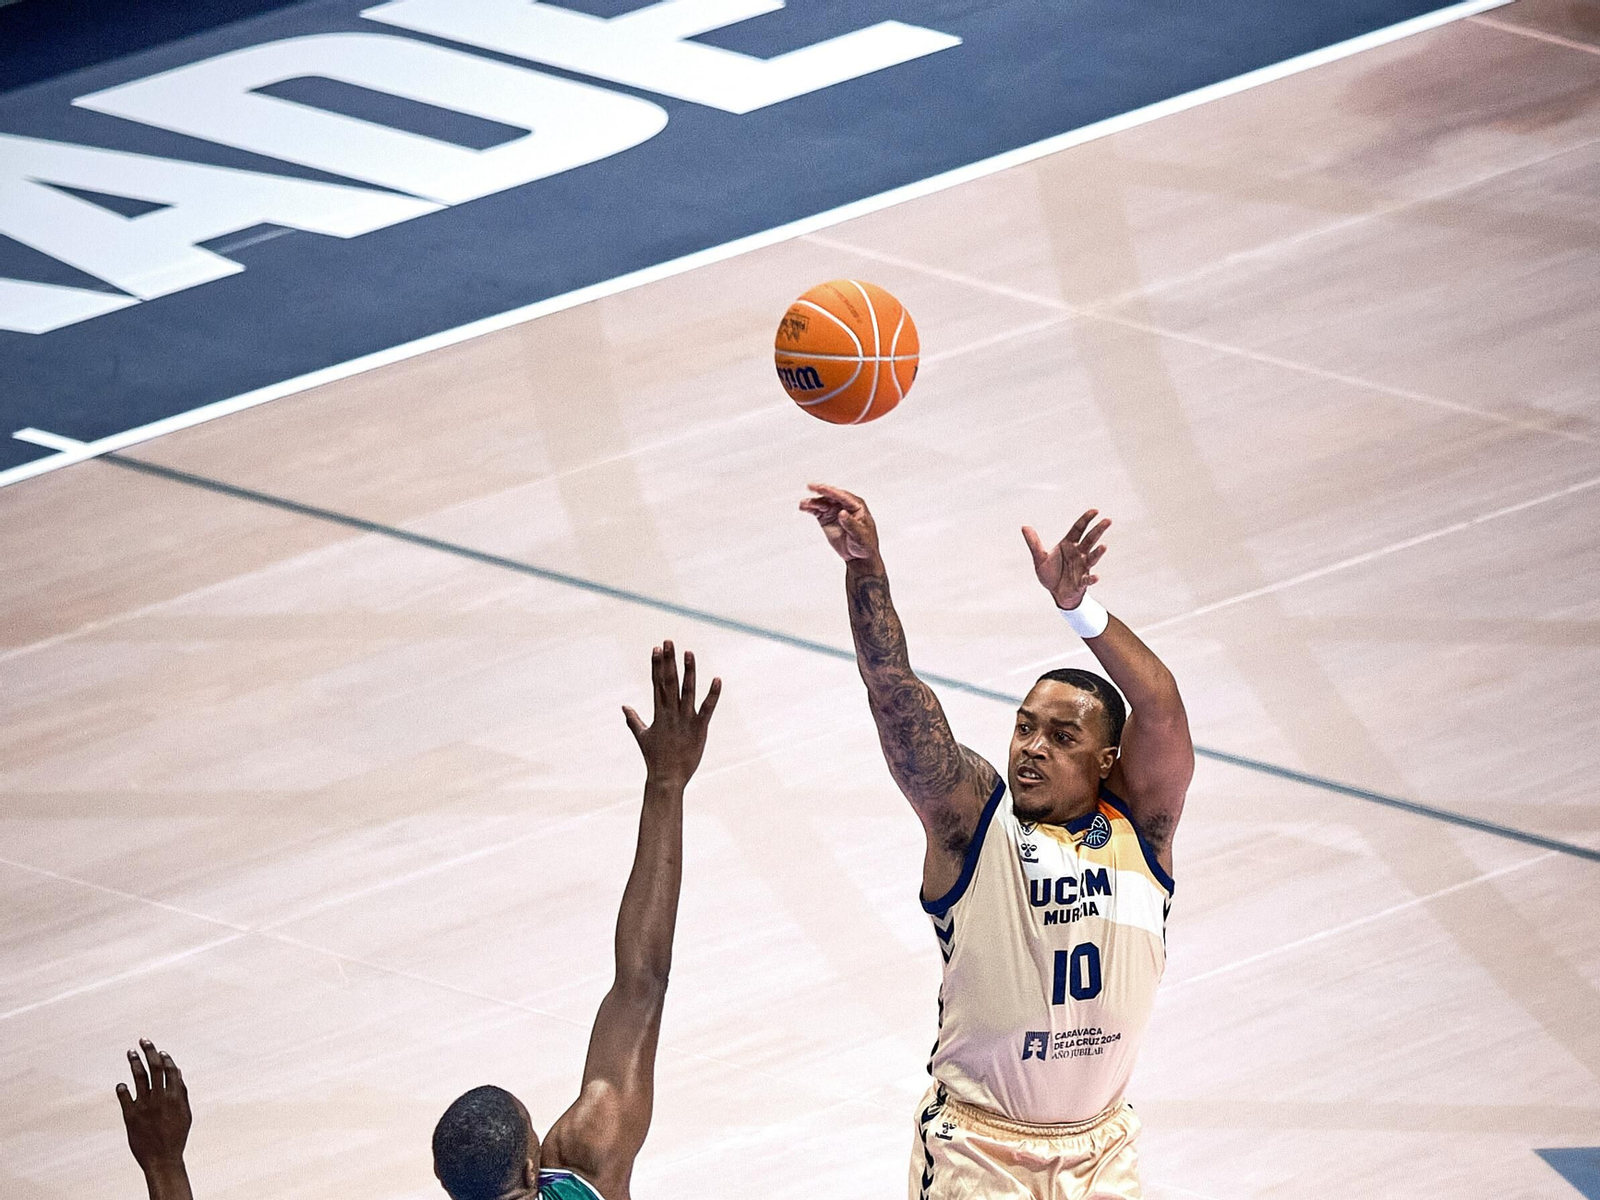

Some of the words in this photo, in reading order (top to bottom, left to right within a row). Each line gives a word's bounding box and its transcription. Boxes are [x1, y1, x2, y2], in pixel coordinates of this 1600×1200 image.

[0, 0, 963, 334] ADE
[1052, 942, 1102, 1005] 10
[1055, 1028, 1102, 1040] CARAVACA
[1054, 1041, 1064, 1050] DE
[1065, 1039, 1075, 1048] LA
[1076, 1037, 1100, 1047] CRUZ
[1070, 1047, 1104, 1059] JUBILAR
